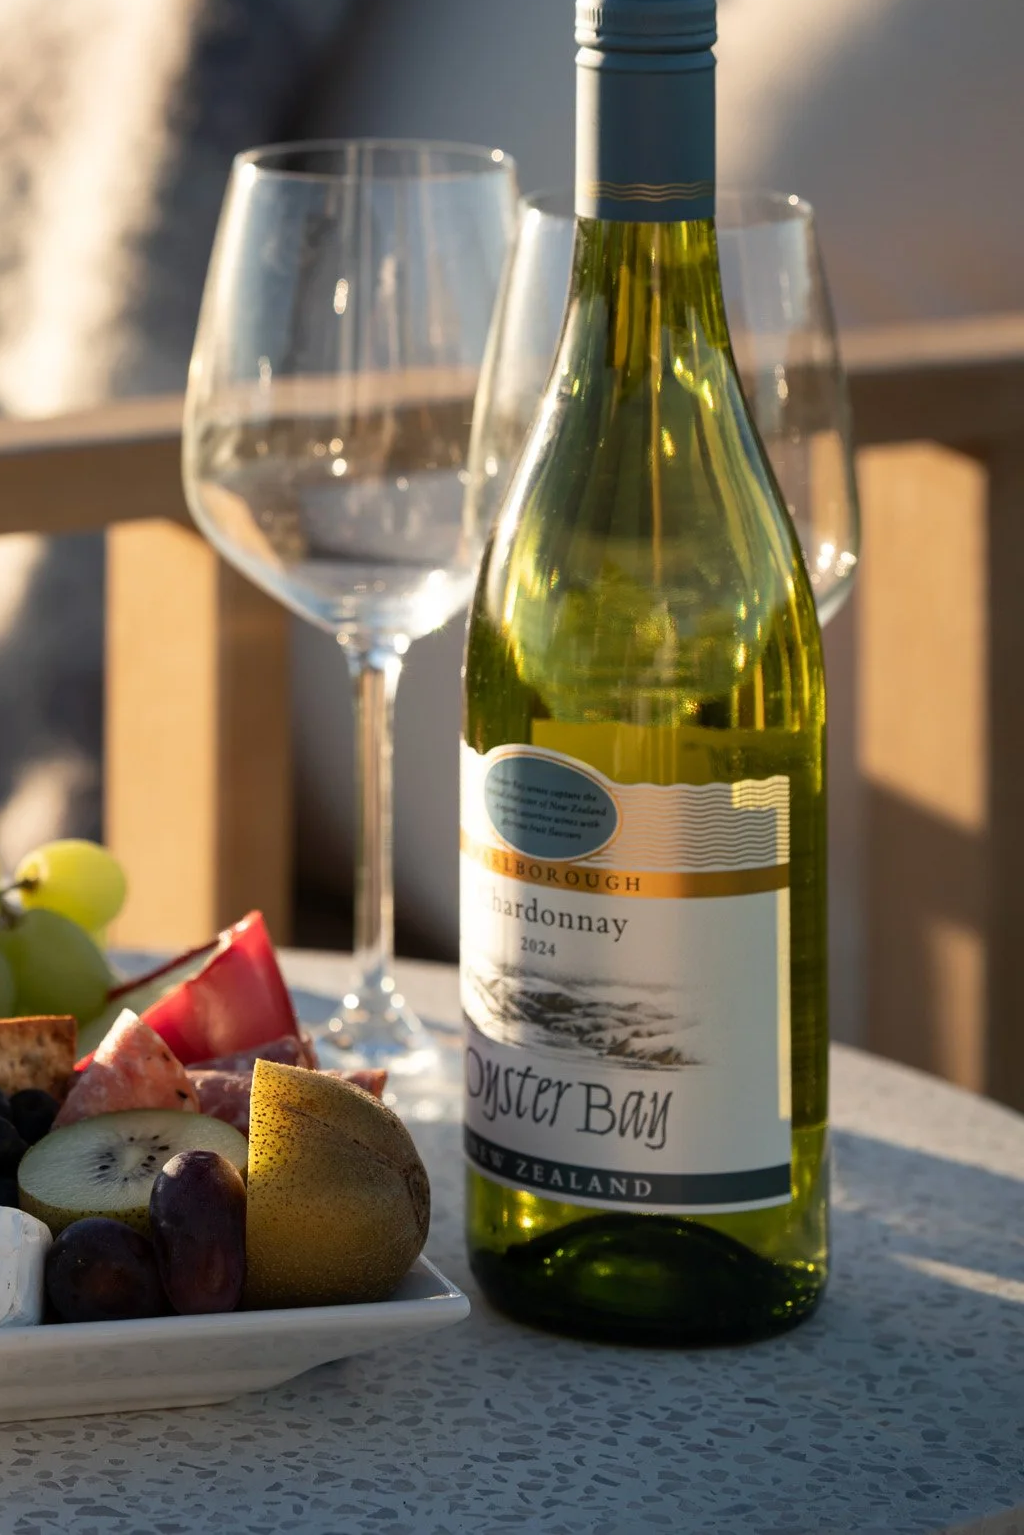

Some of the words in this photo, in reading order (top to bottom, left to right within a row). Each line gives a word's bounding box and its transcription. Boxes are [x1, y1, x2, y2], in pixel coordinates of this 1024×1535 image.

[549, 800, 569, 811] New
[570, 804, 608, 817] Zealand
[582, 791, 598, 802] the
[474, 847, 641, 892] ARLBOROUGH
[486, 886, 629, 943] hardonnay
[520, 936, 557, 957] 2024
[466, 1046, 573, 1128] Oyster
[576, 1081, 674, 1151] Bay
[516, 1160, 653, 1198] ZEALAND
